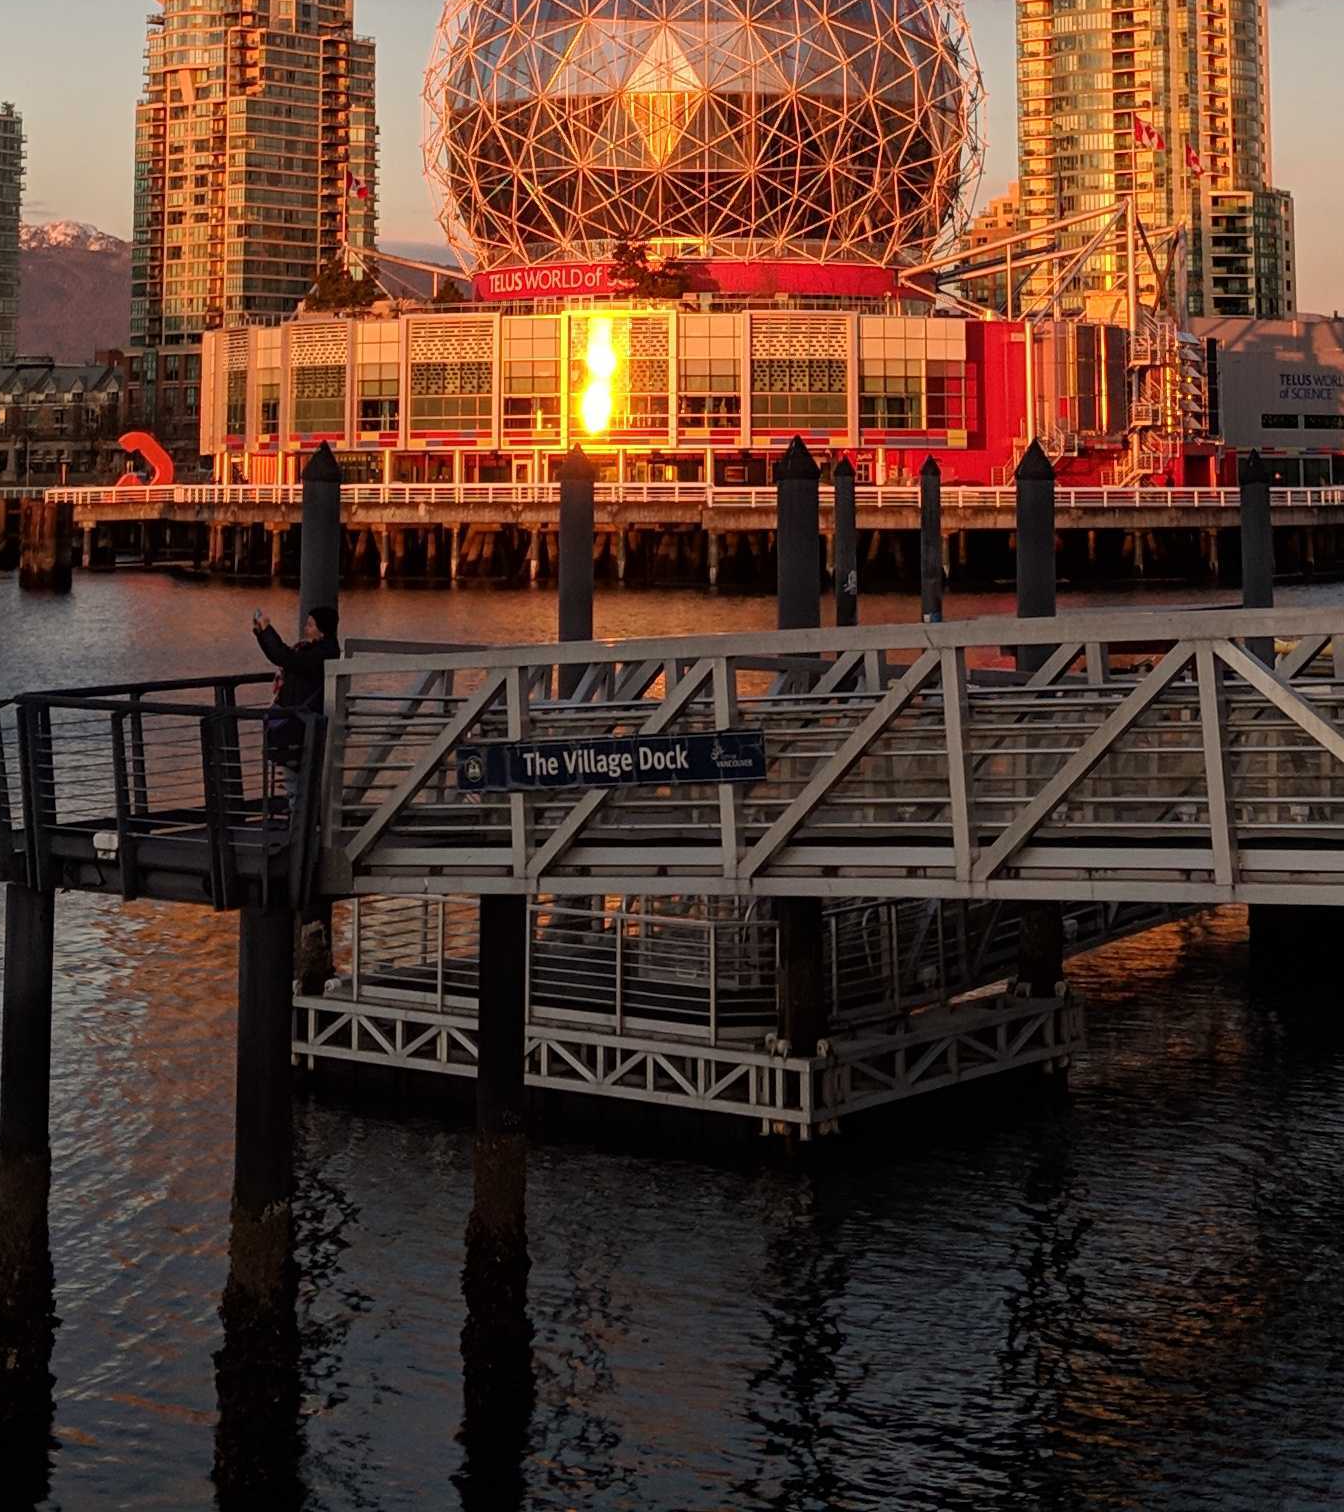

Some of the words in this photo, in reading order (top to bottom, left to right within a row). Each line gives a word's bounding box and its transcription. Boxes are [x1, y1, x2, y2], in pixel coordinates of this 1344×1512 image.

[488, 273, 522, 293] TELUS
[524, 270, 582, 289] WORLD
[584, 266, 602, 285] of
[1280, 374, 1311, 385] TELUS
[1290, 388, 1333, 399] SCIENCE
[523, 753, 559, 776] The
[563, 749, 633, 778] Village
[638, 745, 689, 770] Dock
